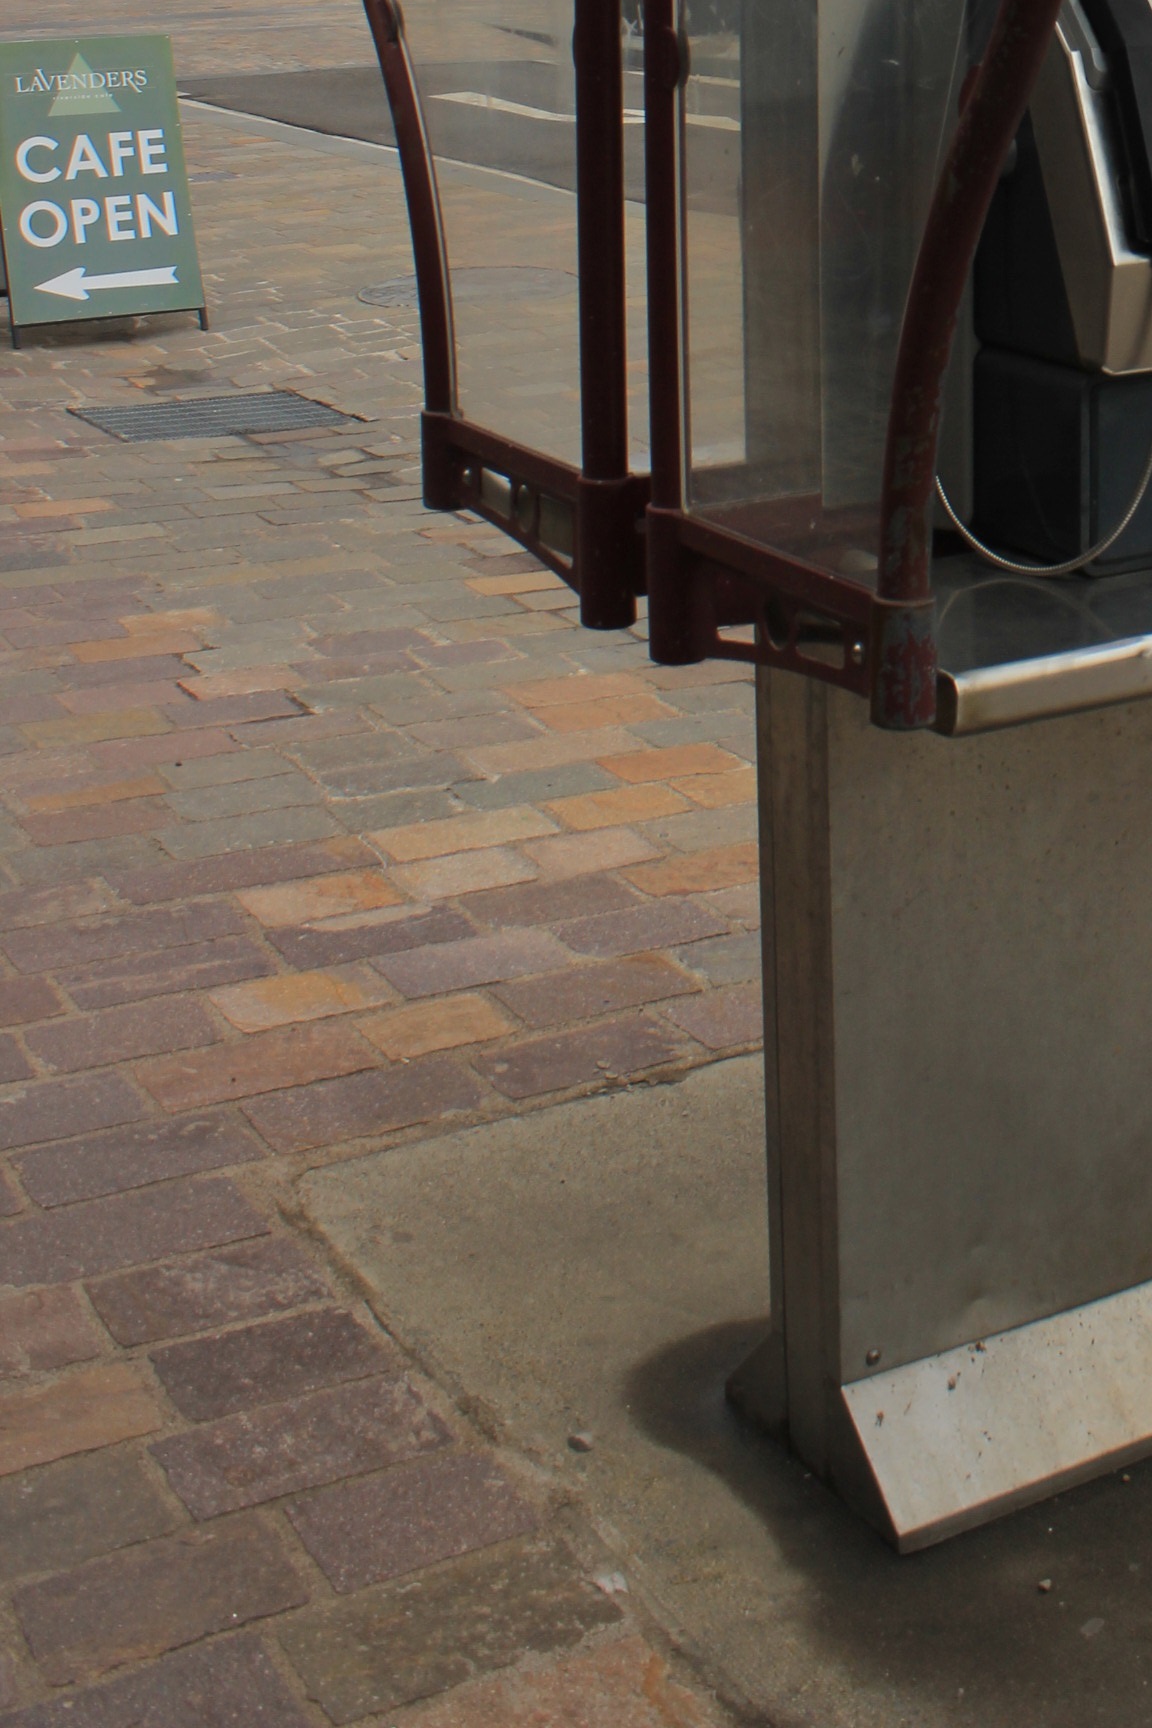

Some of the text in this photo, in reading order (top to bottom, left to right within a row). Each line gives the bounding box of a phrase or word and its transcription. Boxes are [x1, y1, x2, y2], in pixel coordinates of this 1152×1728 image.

[15, 68, 148, 93] LAVENDERS
[15, 128, 168, 184] CAFE
[19, 190, 179, 249] OPEN
